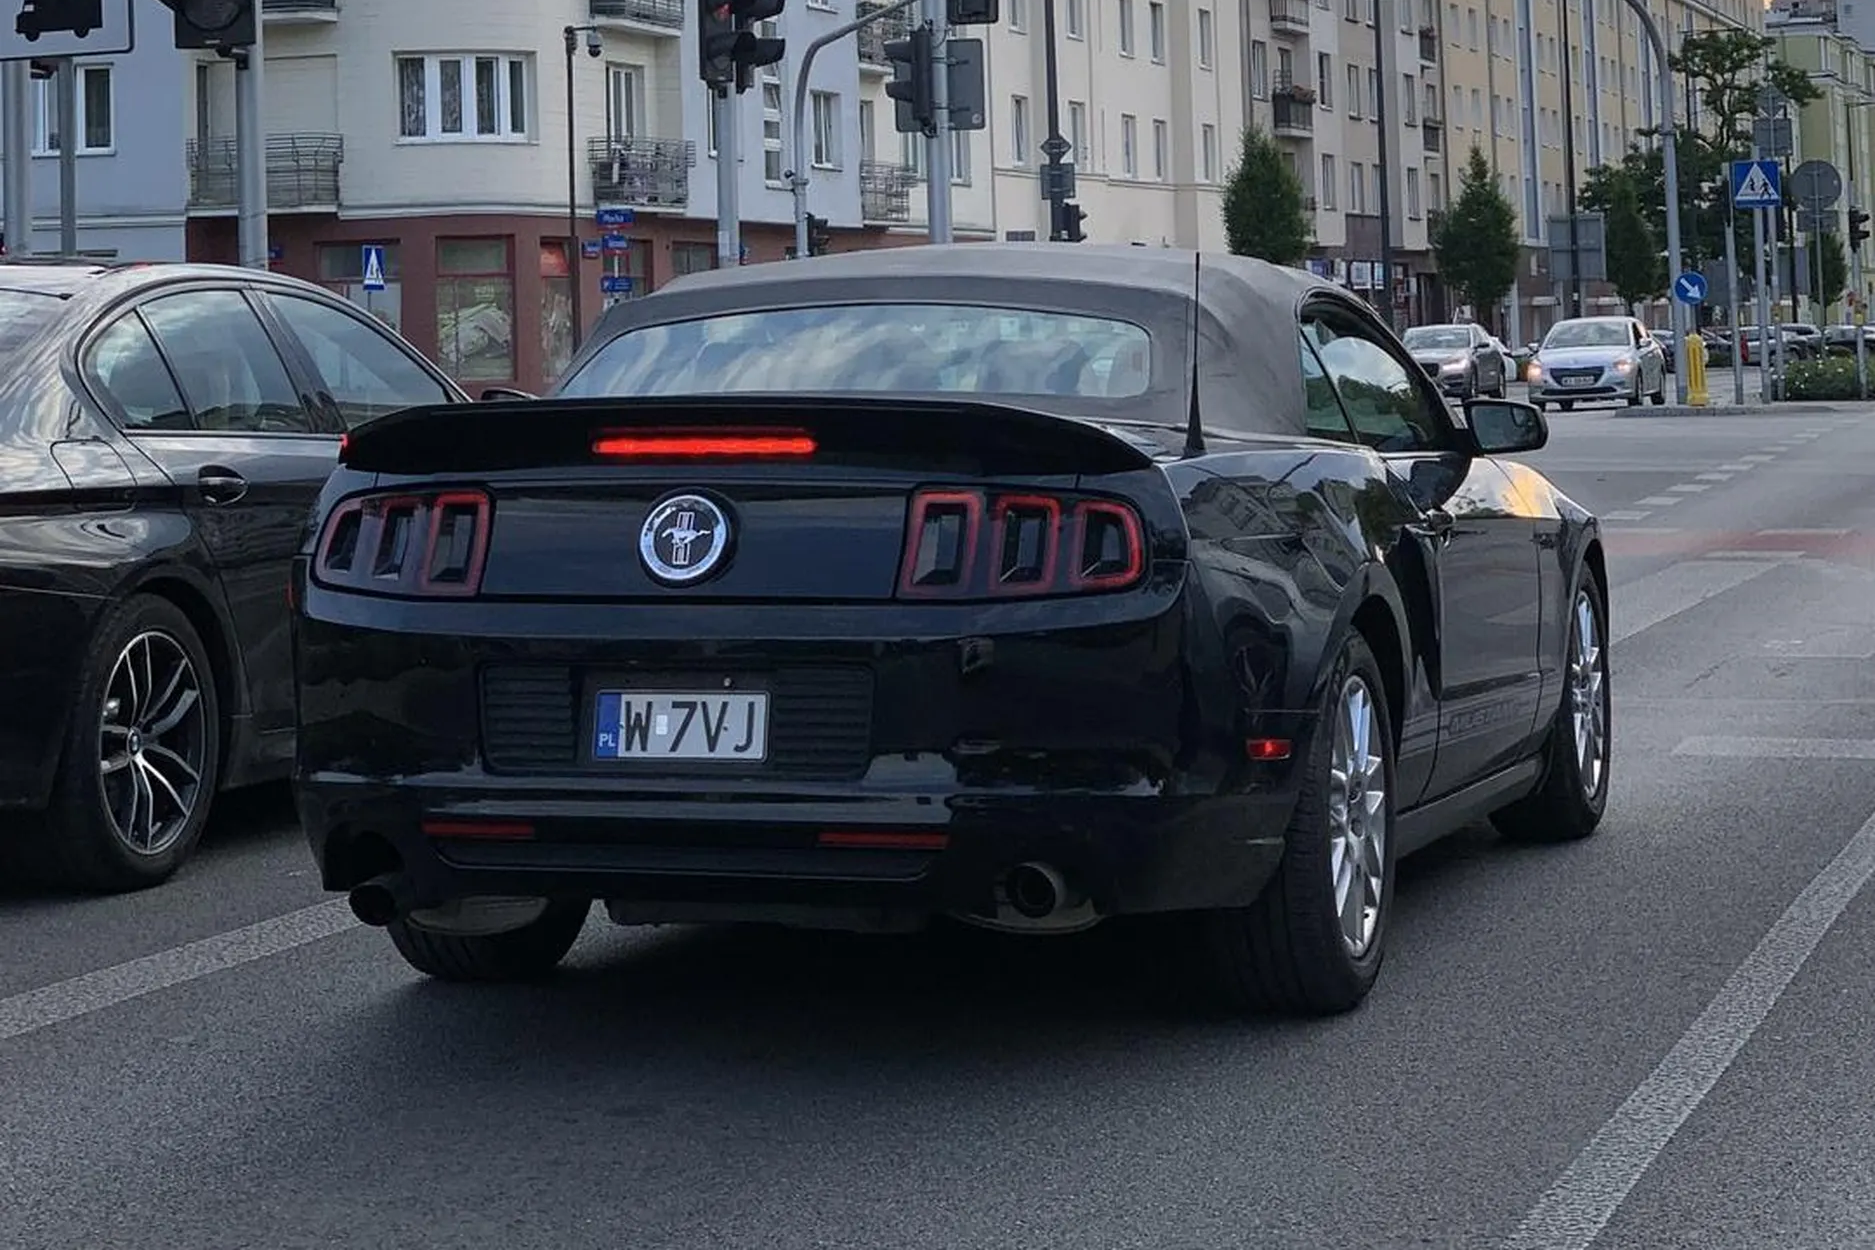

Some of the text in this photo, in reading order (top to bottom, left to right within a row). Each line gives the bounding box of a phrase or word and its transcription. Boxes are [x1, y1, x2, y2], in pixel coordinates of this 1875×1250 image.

[599, 733, 616, 747] PL
[625, 701, 755, 753] W 7VJ
